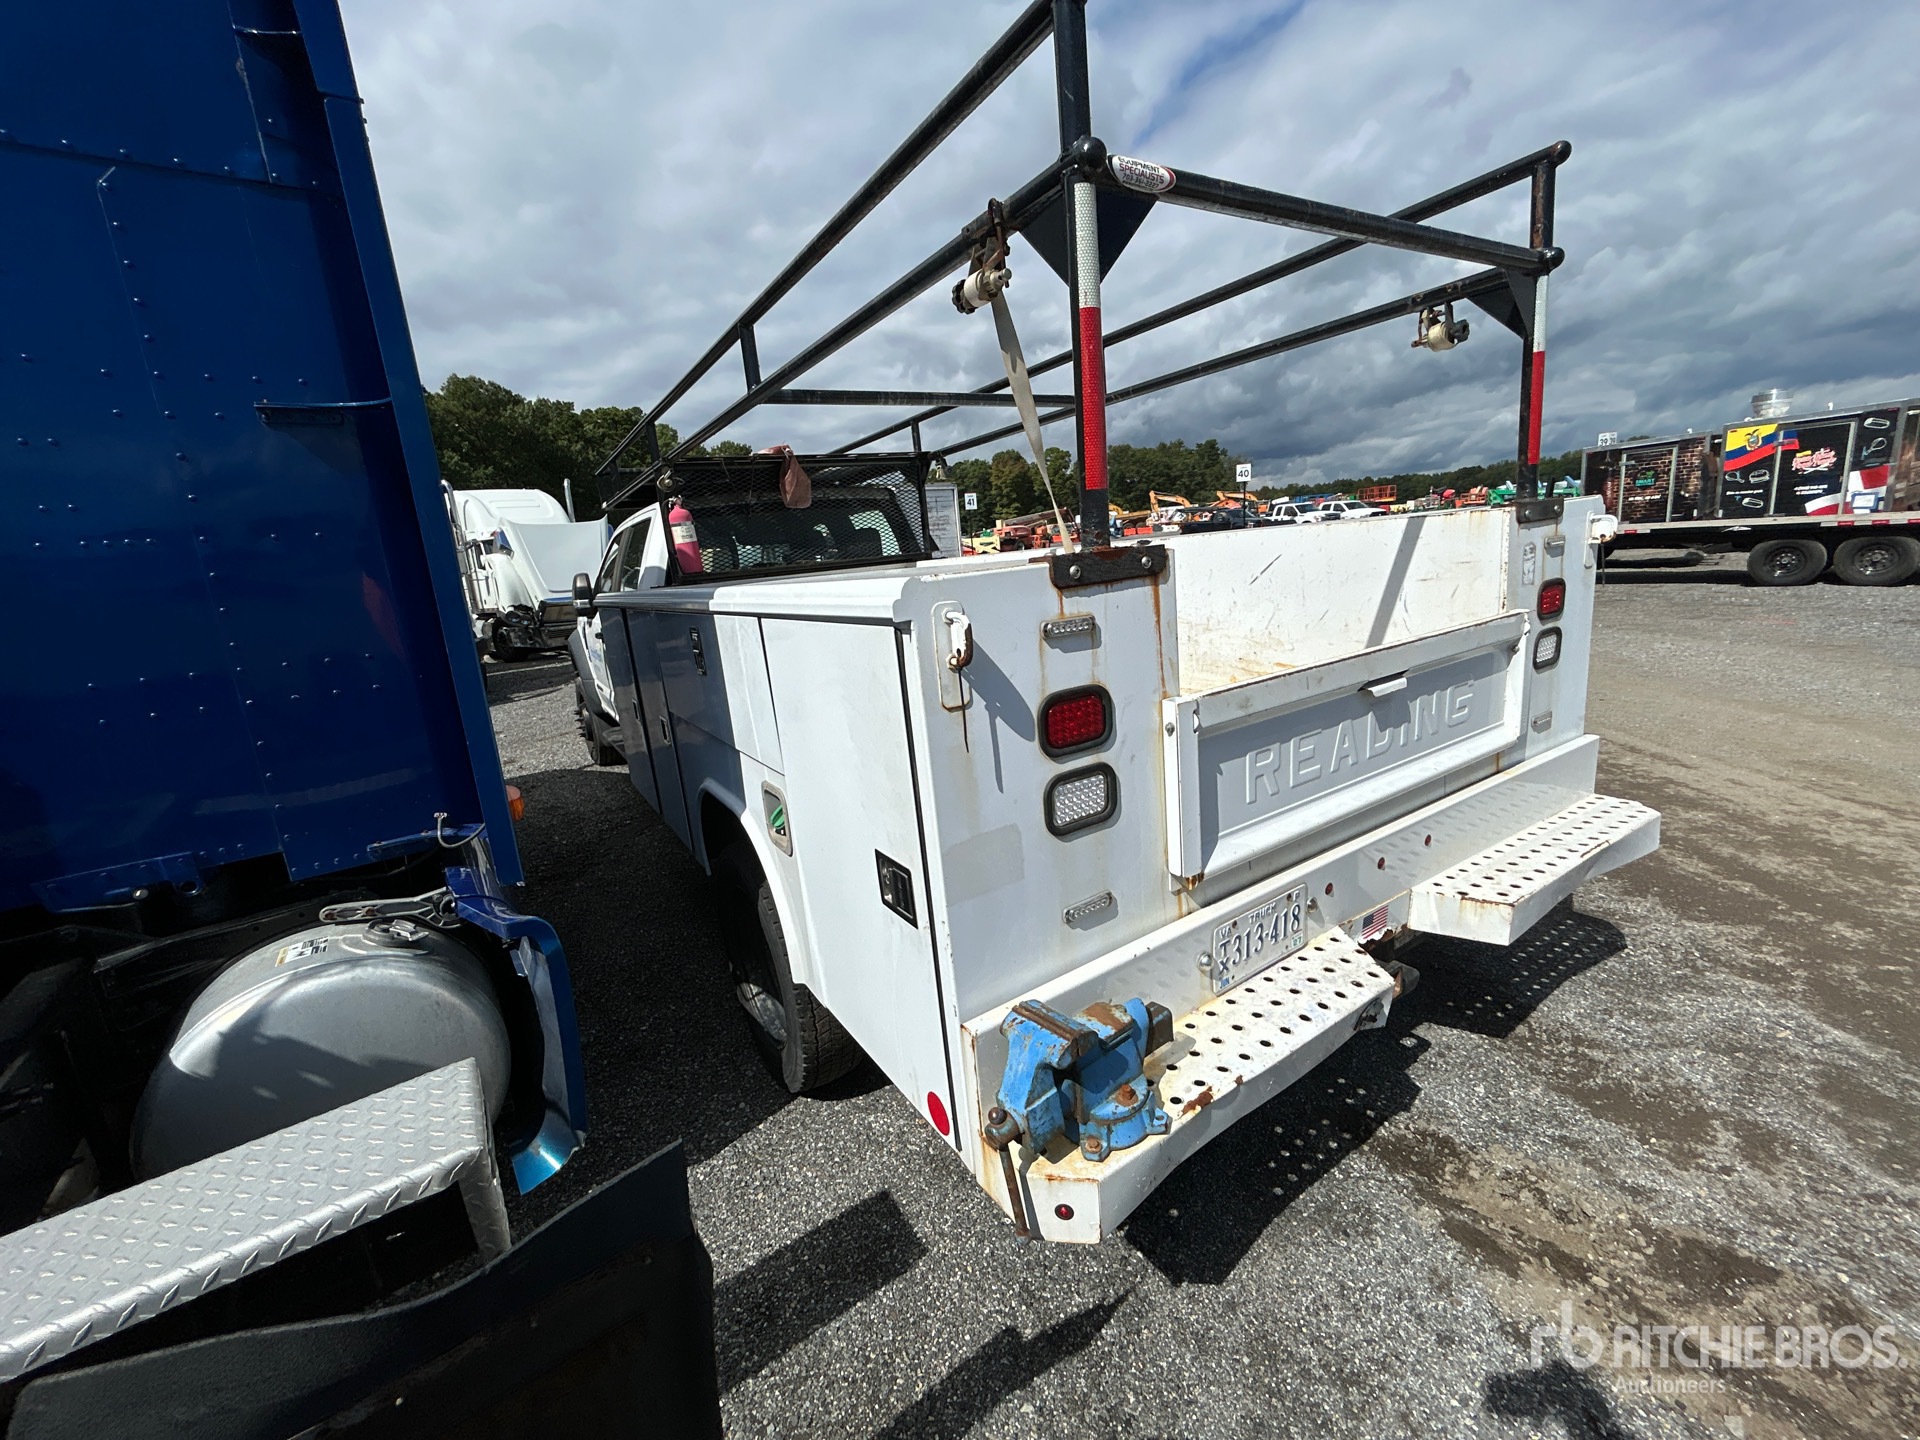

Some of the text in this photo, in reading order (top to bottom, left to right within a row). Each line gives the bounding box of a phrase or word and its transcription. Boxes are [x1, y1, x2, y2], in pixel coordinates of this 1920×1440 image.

[1118, 156, 1160, 174] EQUIPMENT
[1119, 163, 1165, 184] SPECIALISTS
[1600, 437, 1608, 446] 39
[1237, 470, 1250, 478] 40
[967, 498, 975, 506] 41
[1245, 675, 1477, 805] READING
[1248, 902, 1276, 923] TRUCK
[1219, 926, 1231, 938] VA
[1231, 903, 1301, 966] 313-418
